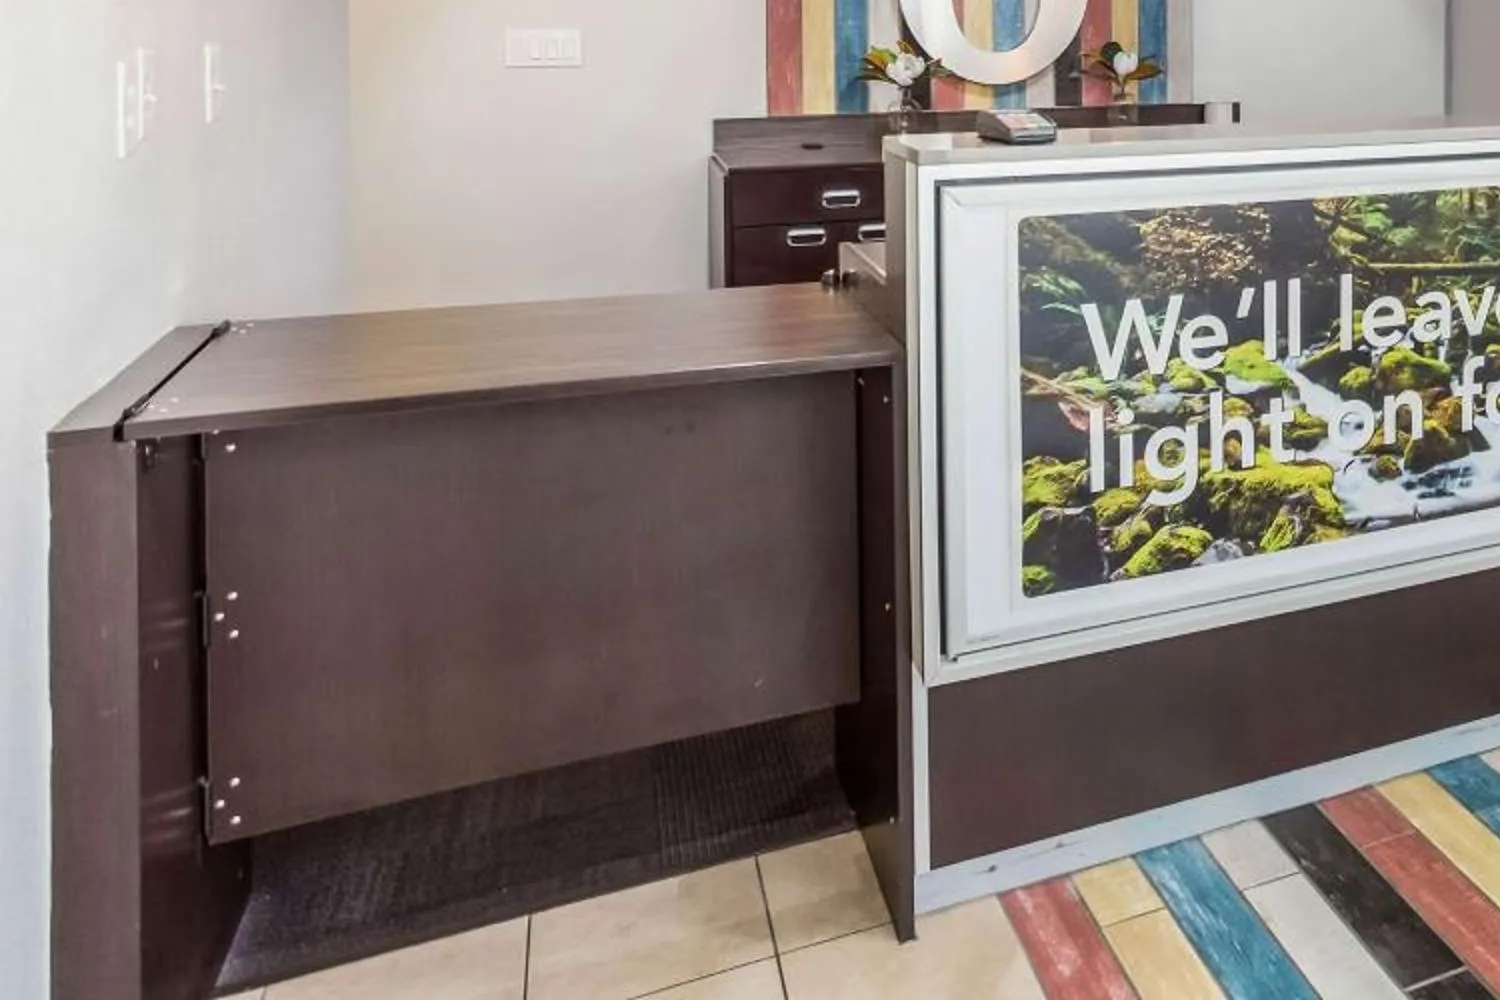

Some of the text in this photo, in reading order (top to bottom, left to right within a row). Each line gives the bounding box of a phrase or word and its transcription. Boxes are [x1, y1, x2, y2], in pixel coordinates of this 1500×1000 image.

[1080, 278, 1301, 380] We'll
[1088, 391, 1296, 506] light
[1328, 389, 1424, 452] on
